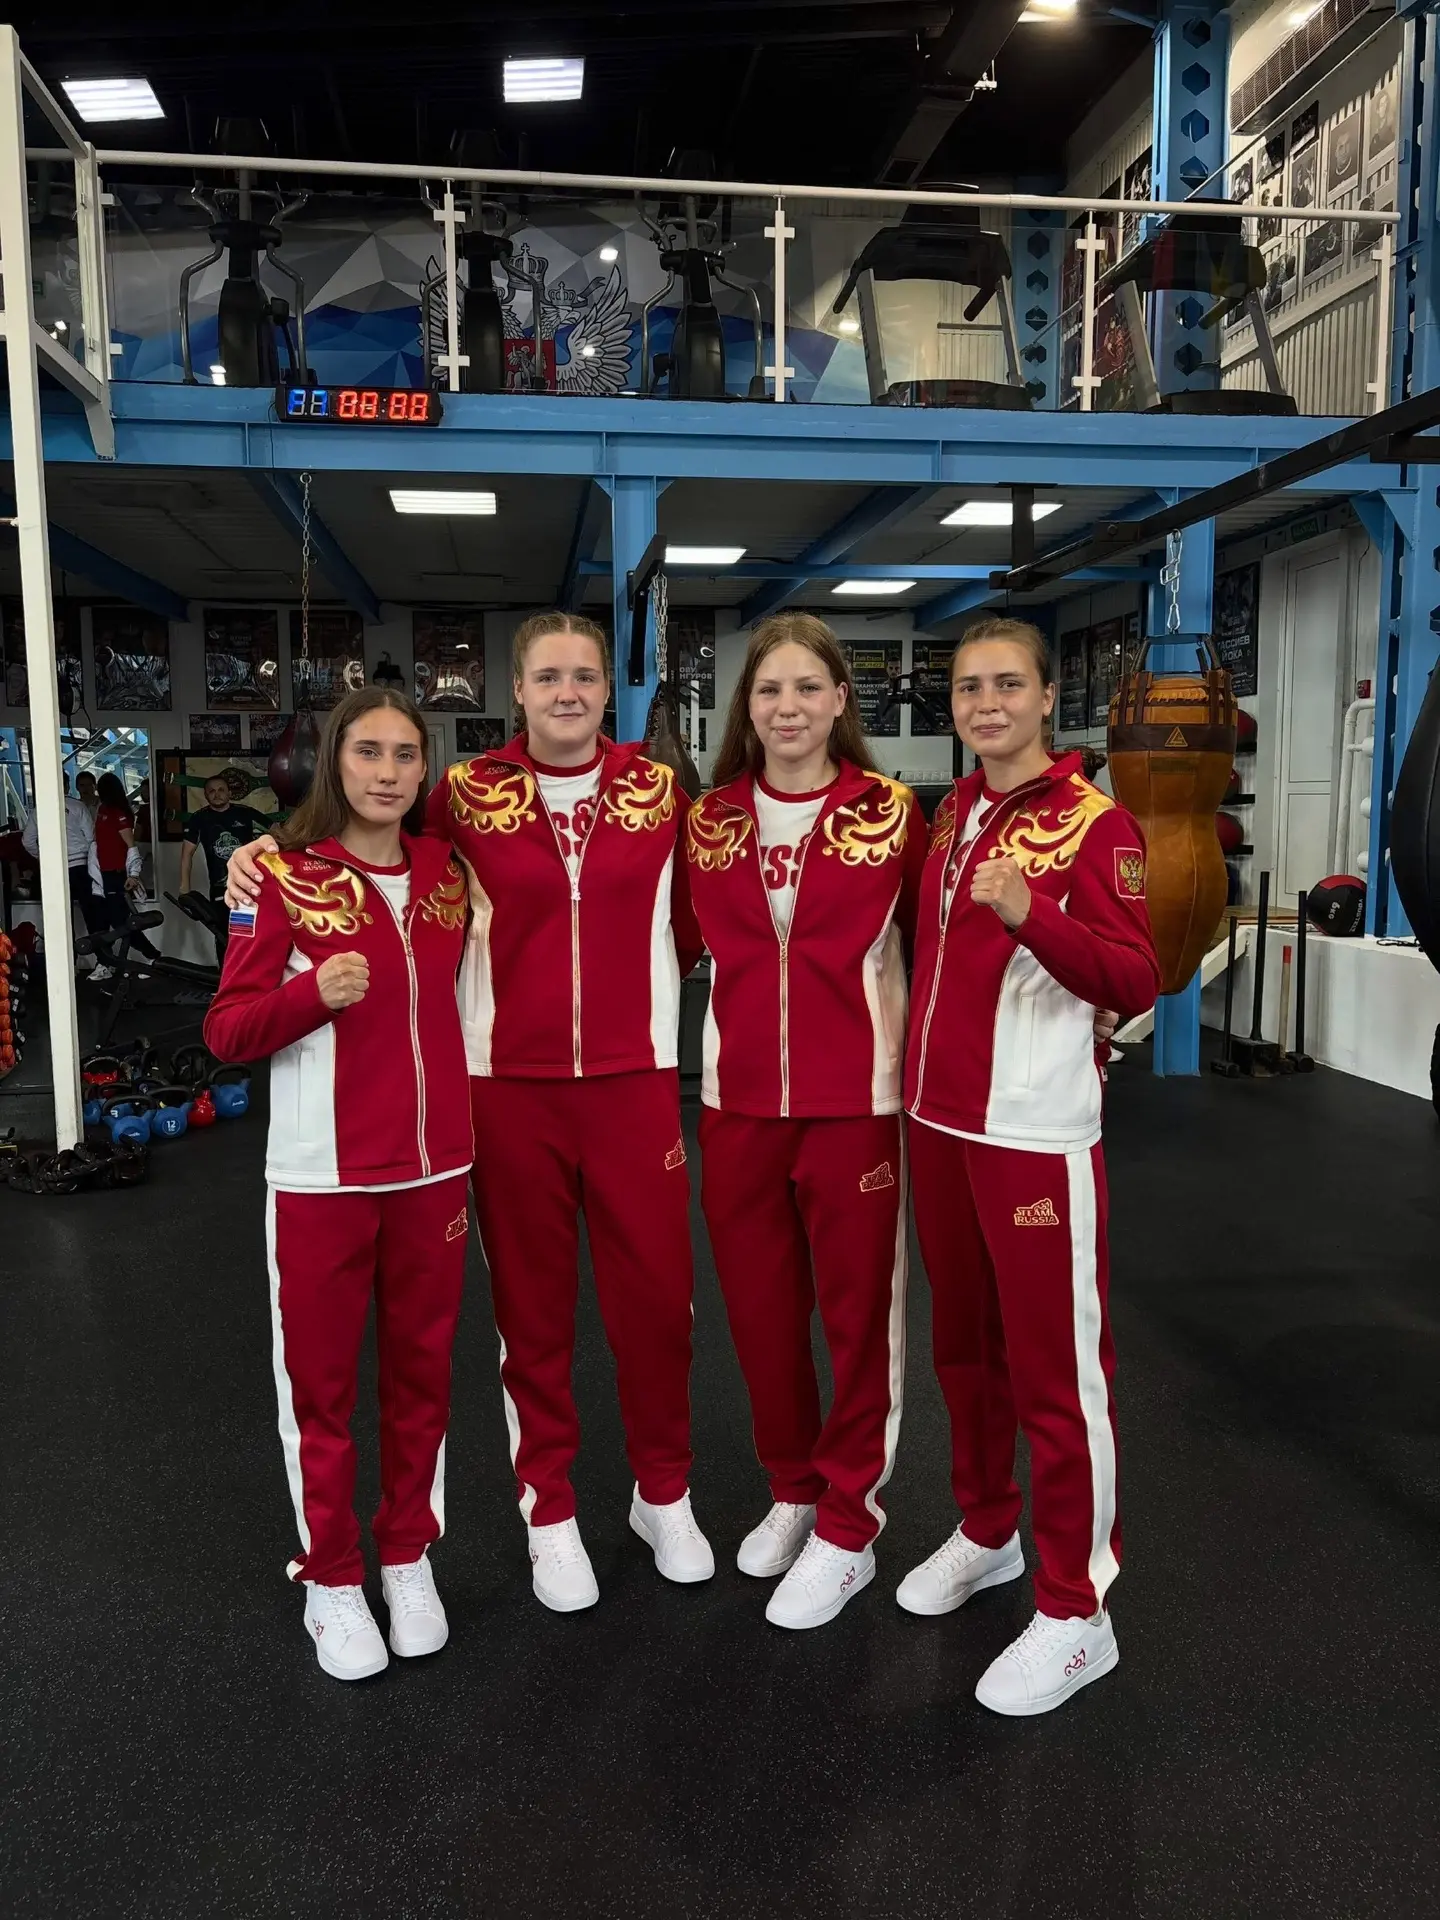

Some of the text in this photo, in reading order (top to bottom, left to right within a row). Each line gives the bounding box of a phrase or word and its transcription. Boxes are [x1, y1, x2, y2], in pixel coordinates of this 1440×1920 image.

[302, 864, 332, 872] RUSSIA
[166, 1120, 176, 1128] 12
[1020, 1208, 1051, 1217] TEAM
[1016, 1216, 1056, 1224] RUSSIA
